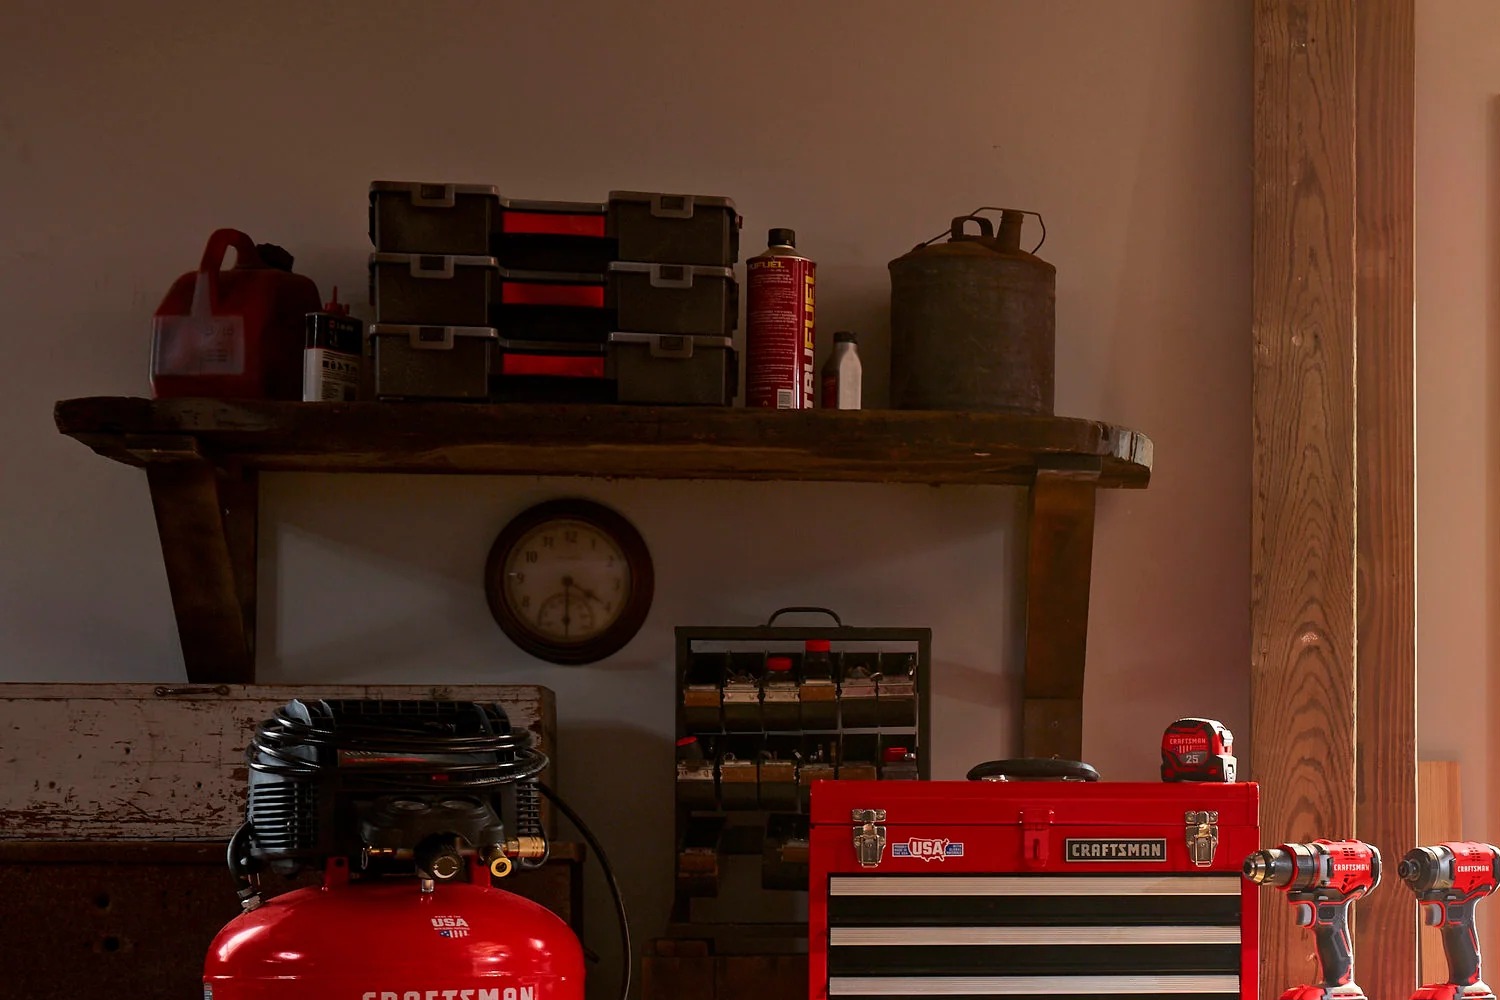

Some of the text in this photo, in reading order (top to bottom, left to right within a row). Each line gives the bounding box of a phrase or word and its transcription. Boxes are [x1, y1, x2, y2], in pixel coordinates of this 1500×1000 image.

[526, 550, 538, 563] 10
[1185, 754, 1199, 764] 25
[912, 841, 943, 855] USA
[1072, 843, 1161, 857] CRAFTSMAN
[1333, 863, 1370, 871] CRAFTSMAN
[431, 918, 469, 927] USA
